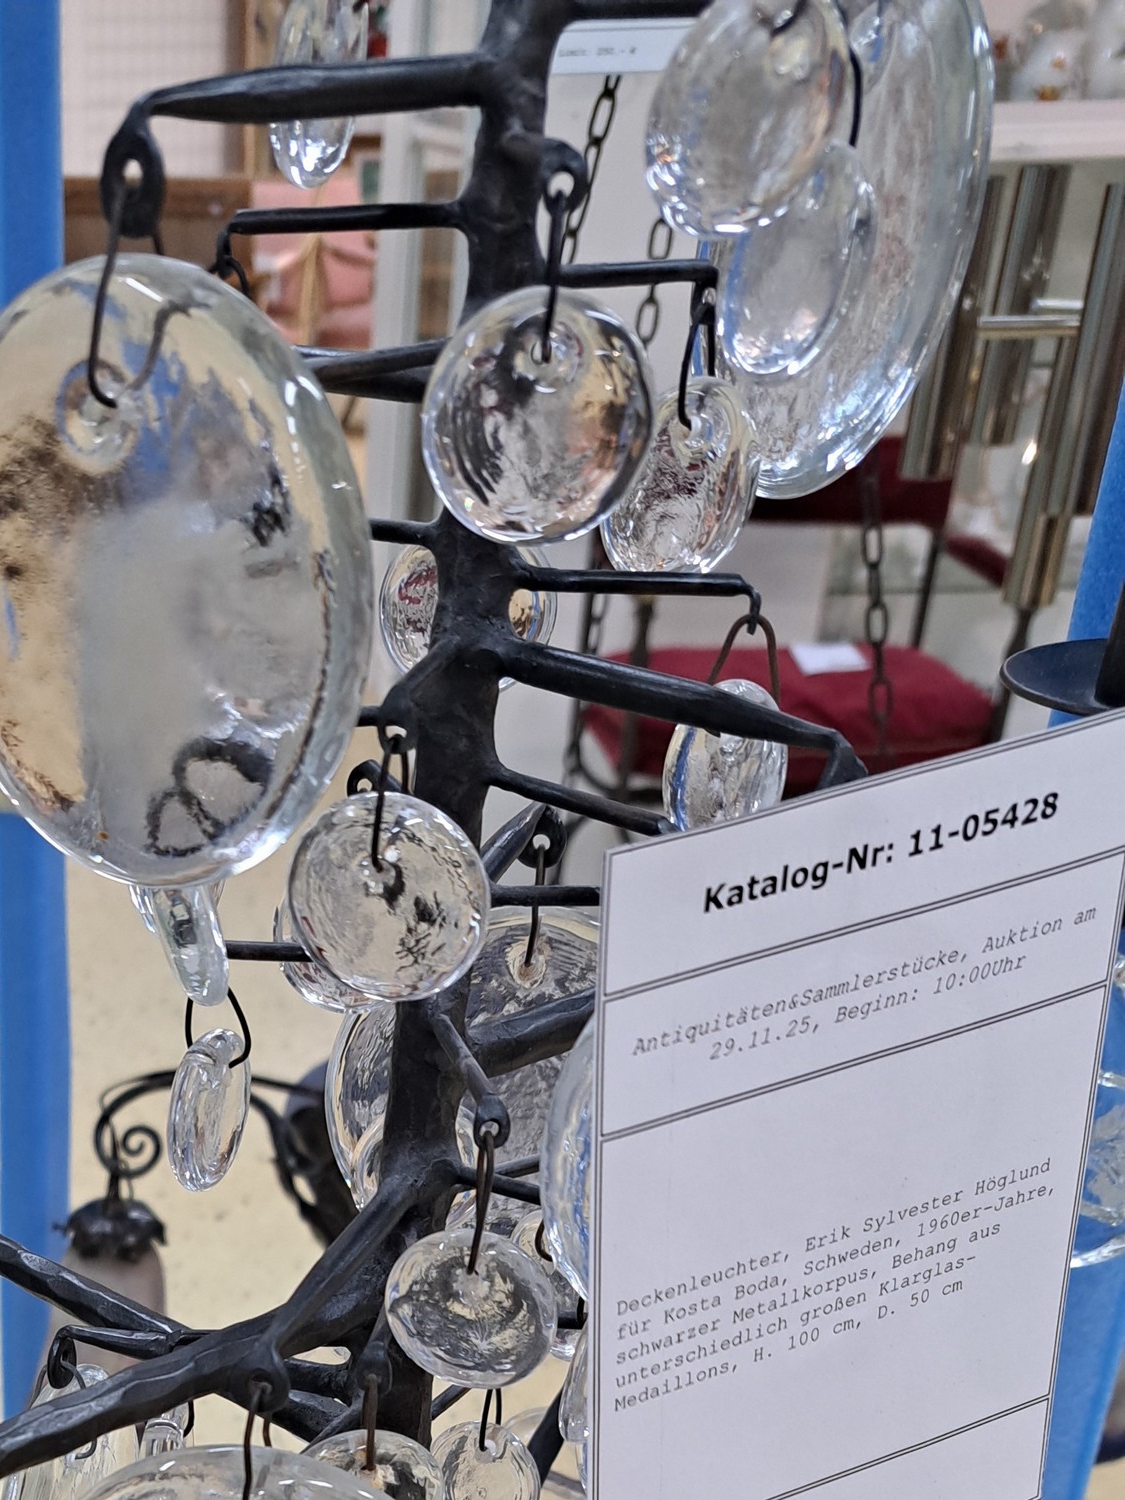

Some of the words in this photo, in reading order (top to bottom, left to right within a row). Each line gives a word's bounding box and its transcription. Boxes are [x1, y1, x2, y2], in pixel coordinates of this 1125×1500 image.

[703, 844, 894, 913] Katalog-Nr:
[908, 792, 1059, 857] 11-05428
[632, 950, 968, 1056] Antiquitäten&Sammlerstücke,
[982, 917, 1062, 953] Auktion
[1074, 906, 1097, 925] am
[709, 1015, 819, 1060] 29.11.25,
[834, 988, 918, 1023] Beginn:
[933, 954, 1026, 994] 10:00Uhr
[616, 1250, 789, 1316] Deckenleuchter,
[805, 1226, 851, 1253] Erik
[863, 1189, 963, 1232] Sylvester
[974, 1157, 1052, 1196] Höglund
[616, 1319, 651, 1340] für
[663, 1294, 722, 1324] Kosta
[734, 1274, 787, 1300] Boda,
[803, 1236, 901, 1276] Schweden,
[917, 1185, 1054, 1238] 1960er-Jahre,
[616, 1319, 721, 1365] schwarzer
[732, 1268, 876, 1324] Metallkorpus,
[891, 1237, 958, 1269] Behang
[968, 1222, 1001, 1243] aus
[613, 1362, 738, 1412] Medaillons,
[753, 1347, 772, 1363] H.
[788, 1327, 820, 1351] 100
[832, 1318, 862, 1335] cm,
[877, 1304, 895, 1319] D.
[909, 1289, 930, 1308] 50
[941, 1278, 964, 1297] cm
[614, 1317, 788, 1388] unterschiedlich
[799, 1292, 867, 1327] großen
[879, 1255, 977, 1297] Klarglas-
